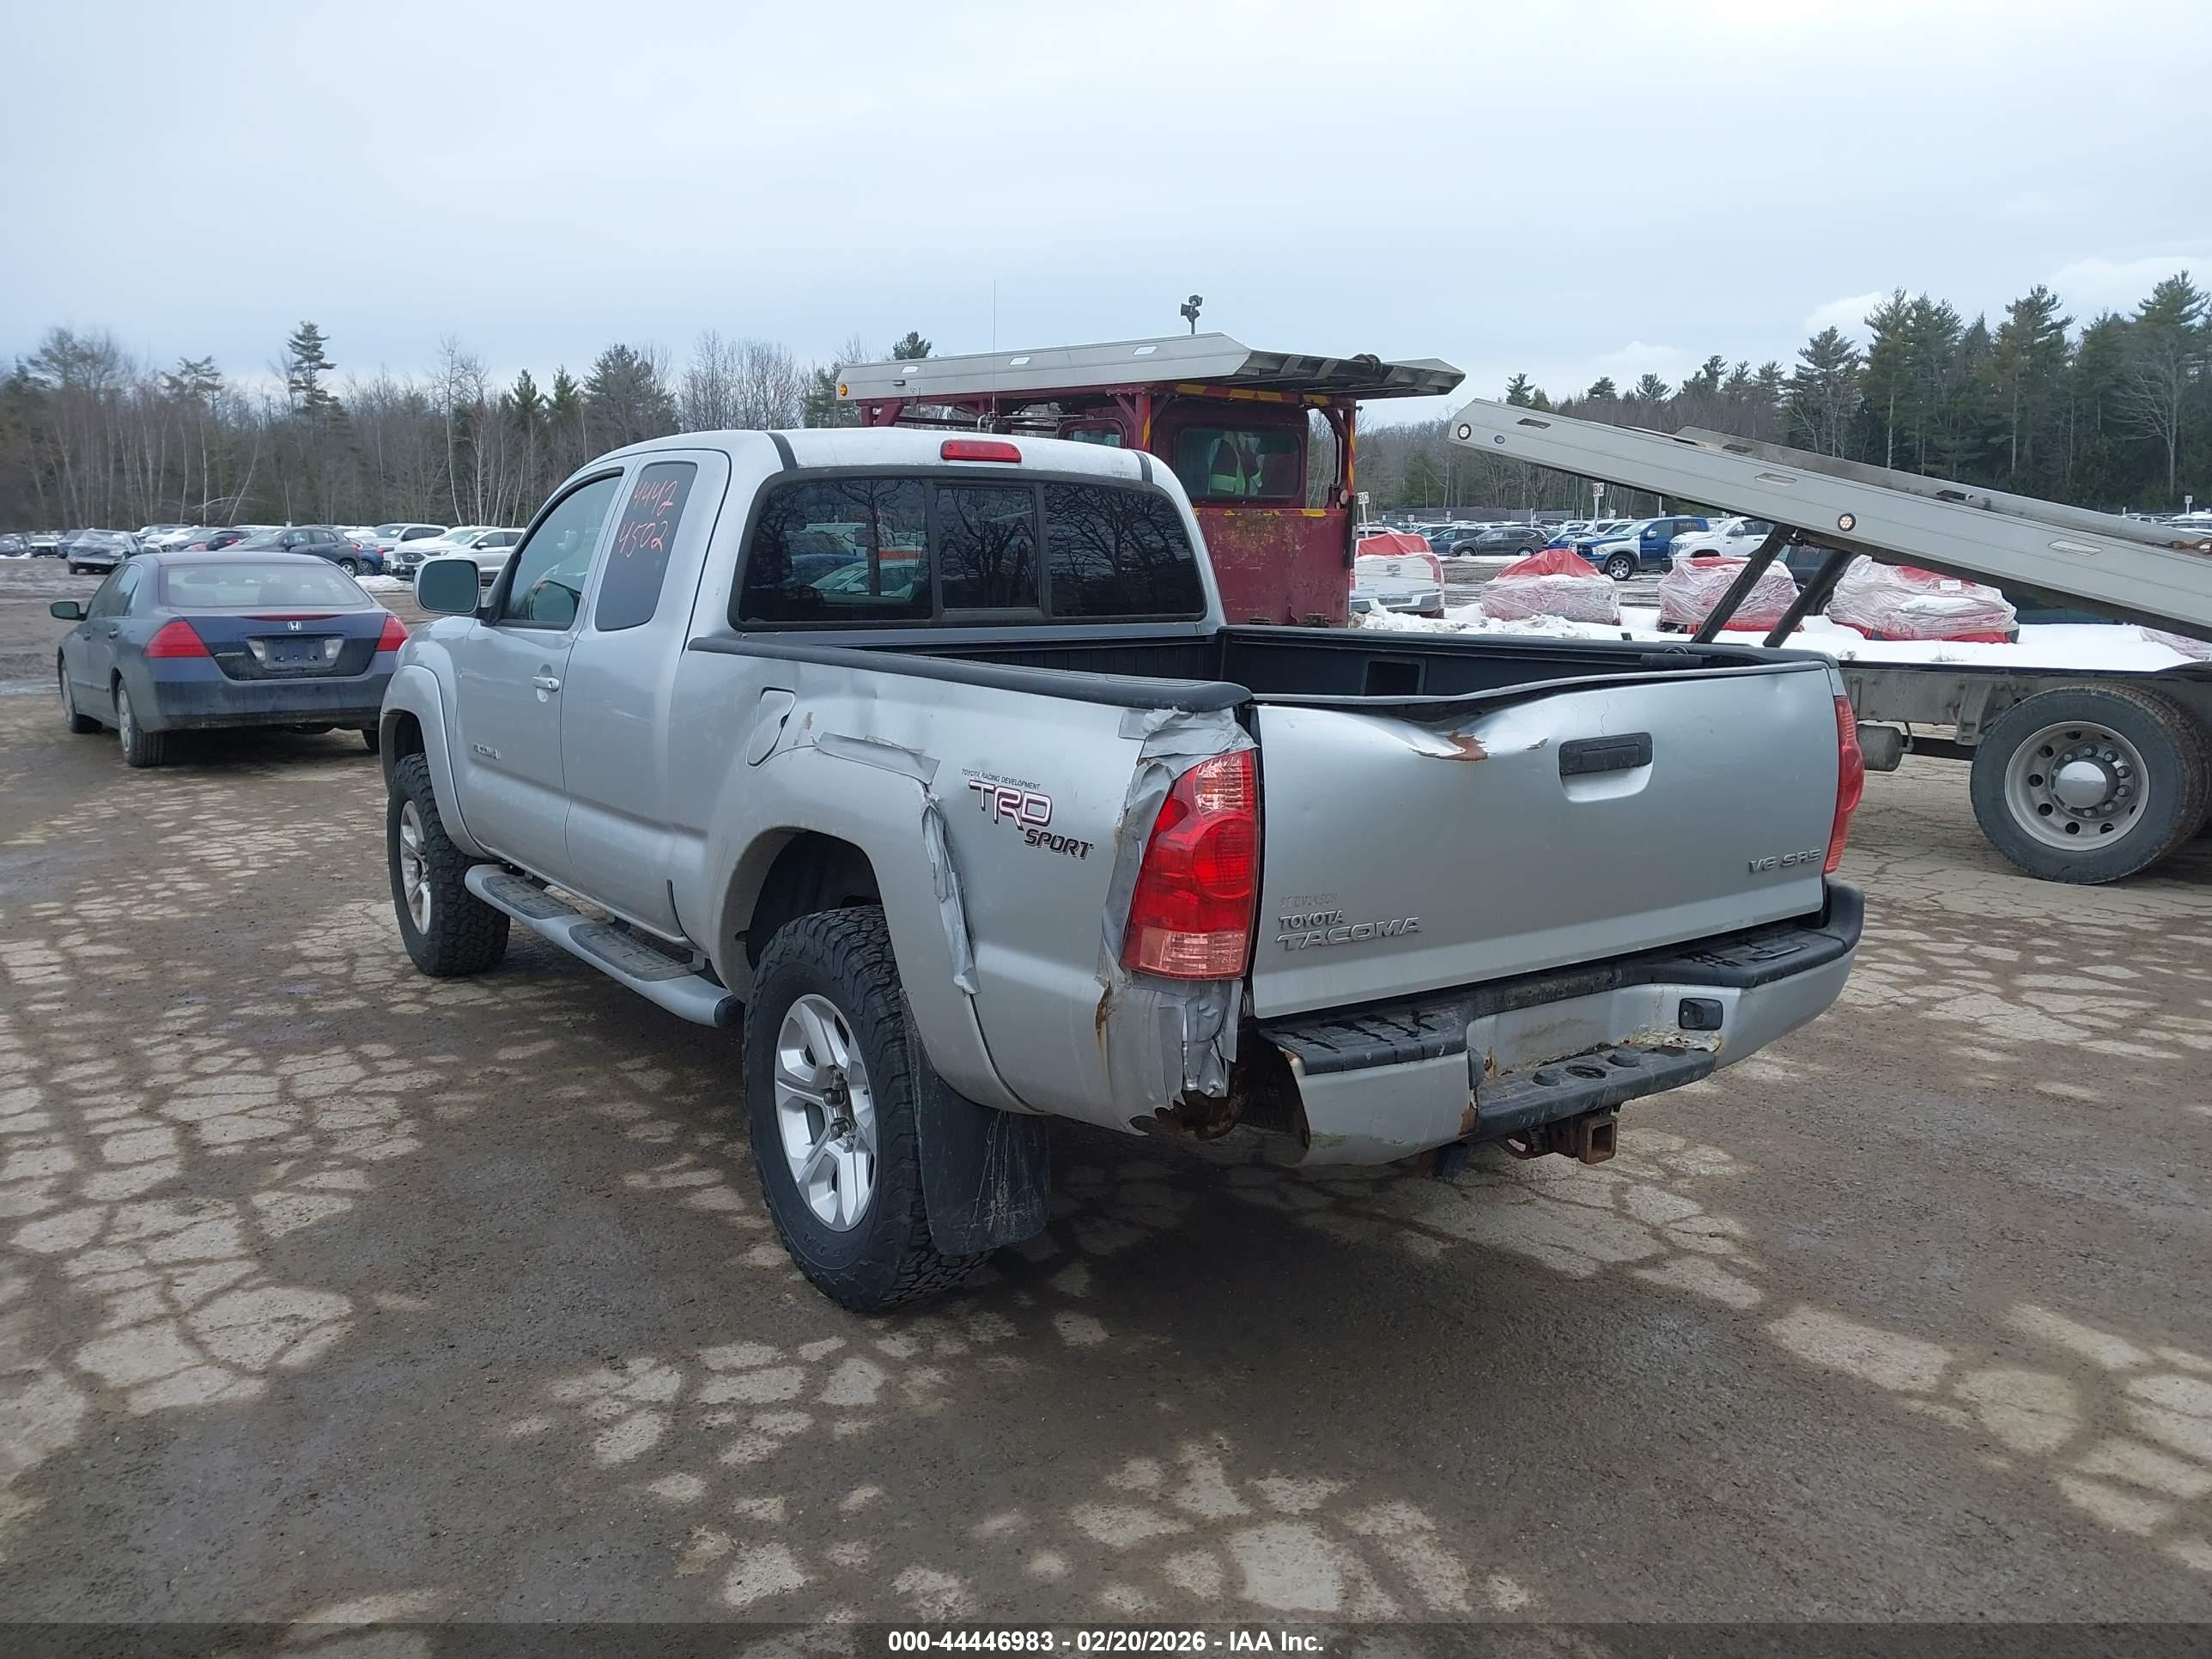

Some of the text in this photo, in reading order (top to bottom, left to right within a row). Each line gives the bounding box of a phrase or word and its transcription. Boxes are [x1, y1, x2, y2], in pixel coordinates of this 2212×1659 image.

[618, 520, 668, 558] 4502
[961, 769, 1042, 791] TOYOTA RACING DEVELOPMENT
[968, 779, 1054, 832] TRD
[1024, 828, 1095, 860] SPORT
[1748, 848, 1821, 873] V6 SR5
[1276, 916, 1423, 951] TACOMA
[1278, 909, 1345, 930] TOYOTA
